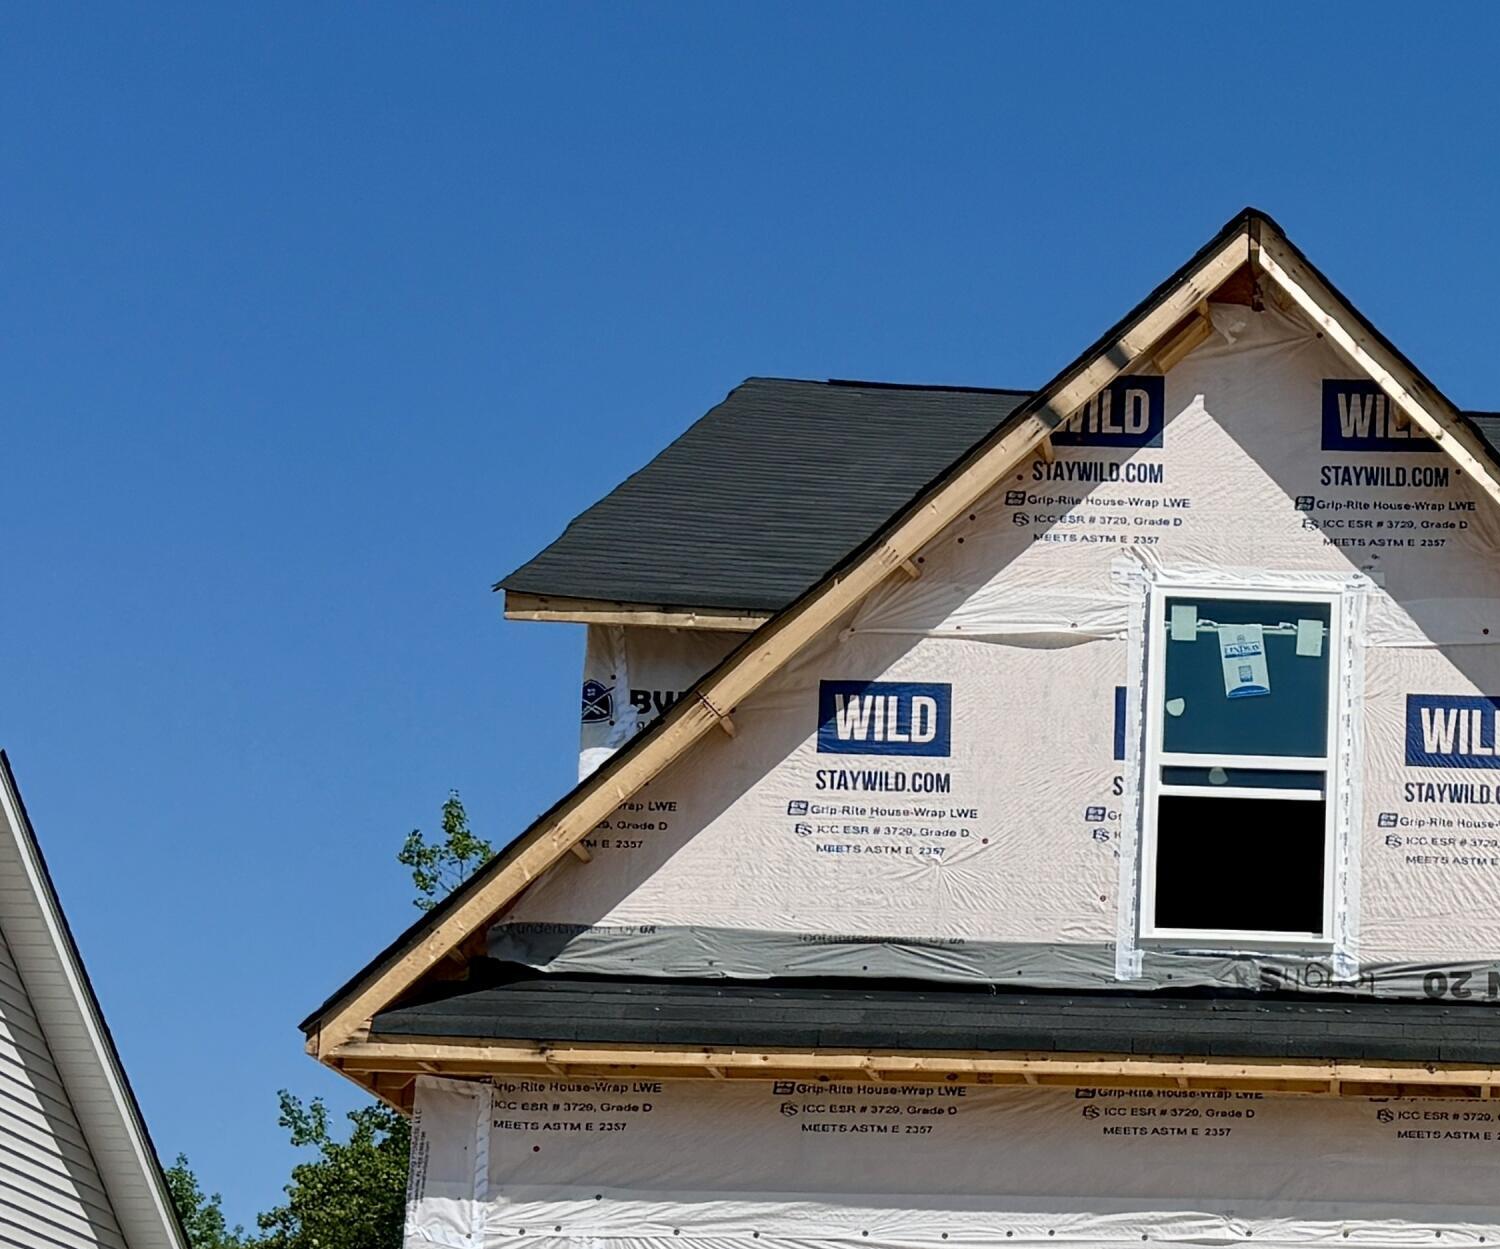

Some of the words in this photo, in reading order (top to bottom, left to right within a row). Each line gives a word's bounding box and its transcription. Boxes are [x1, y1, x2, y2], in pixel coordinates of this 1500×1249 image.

[1032, 461, 1163, 483] STAYWILD.COM
[1321, 466, 1448, 488] STAYWILD.COM
[834, 694, 936, 742] WILD
[816, 770, 950, 793] STAYWILD.COM
[1423, 972, 1472, 998] 20
